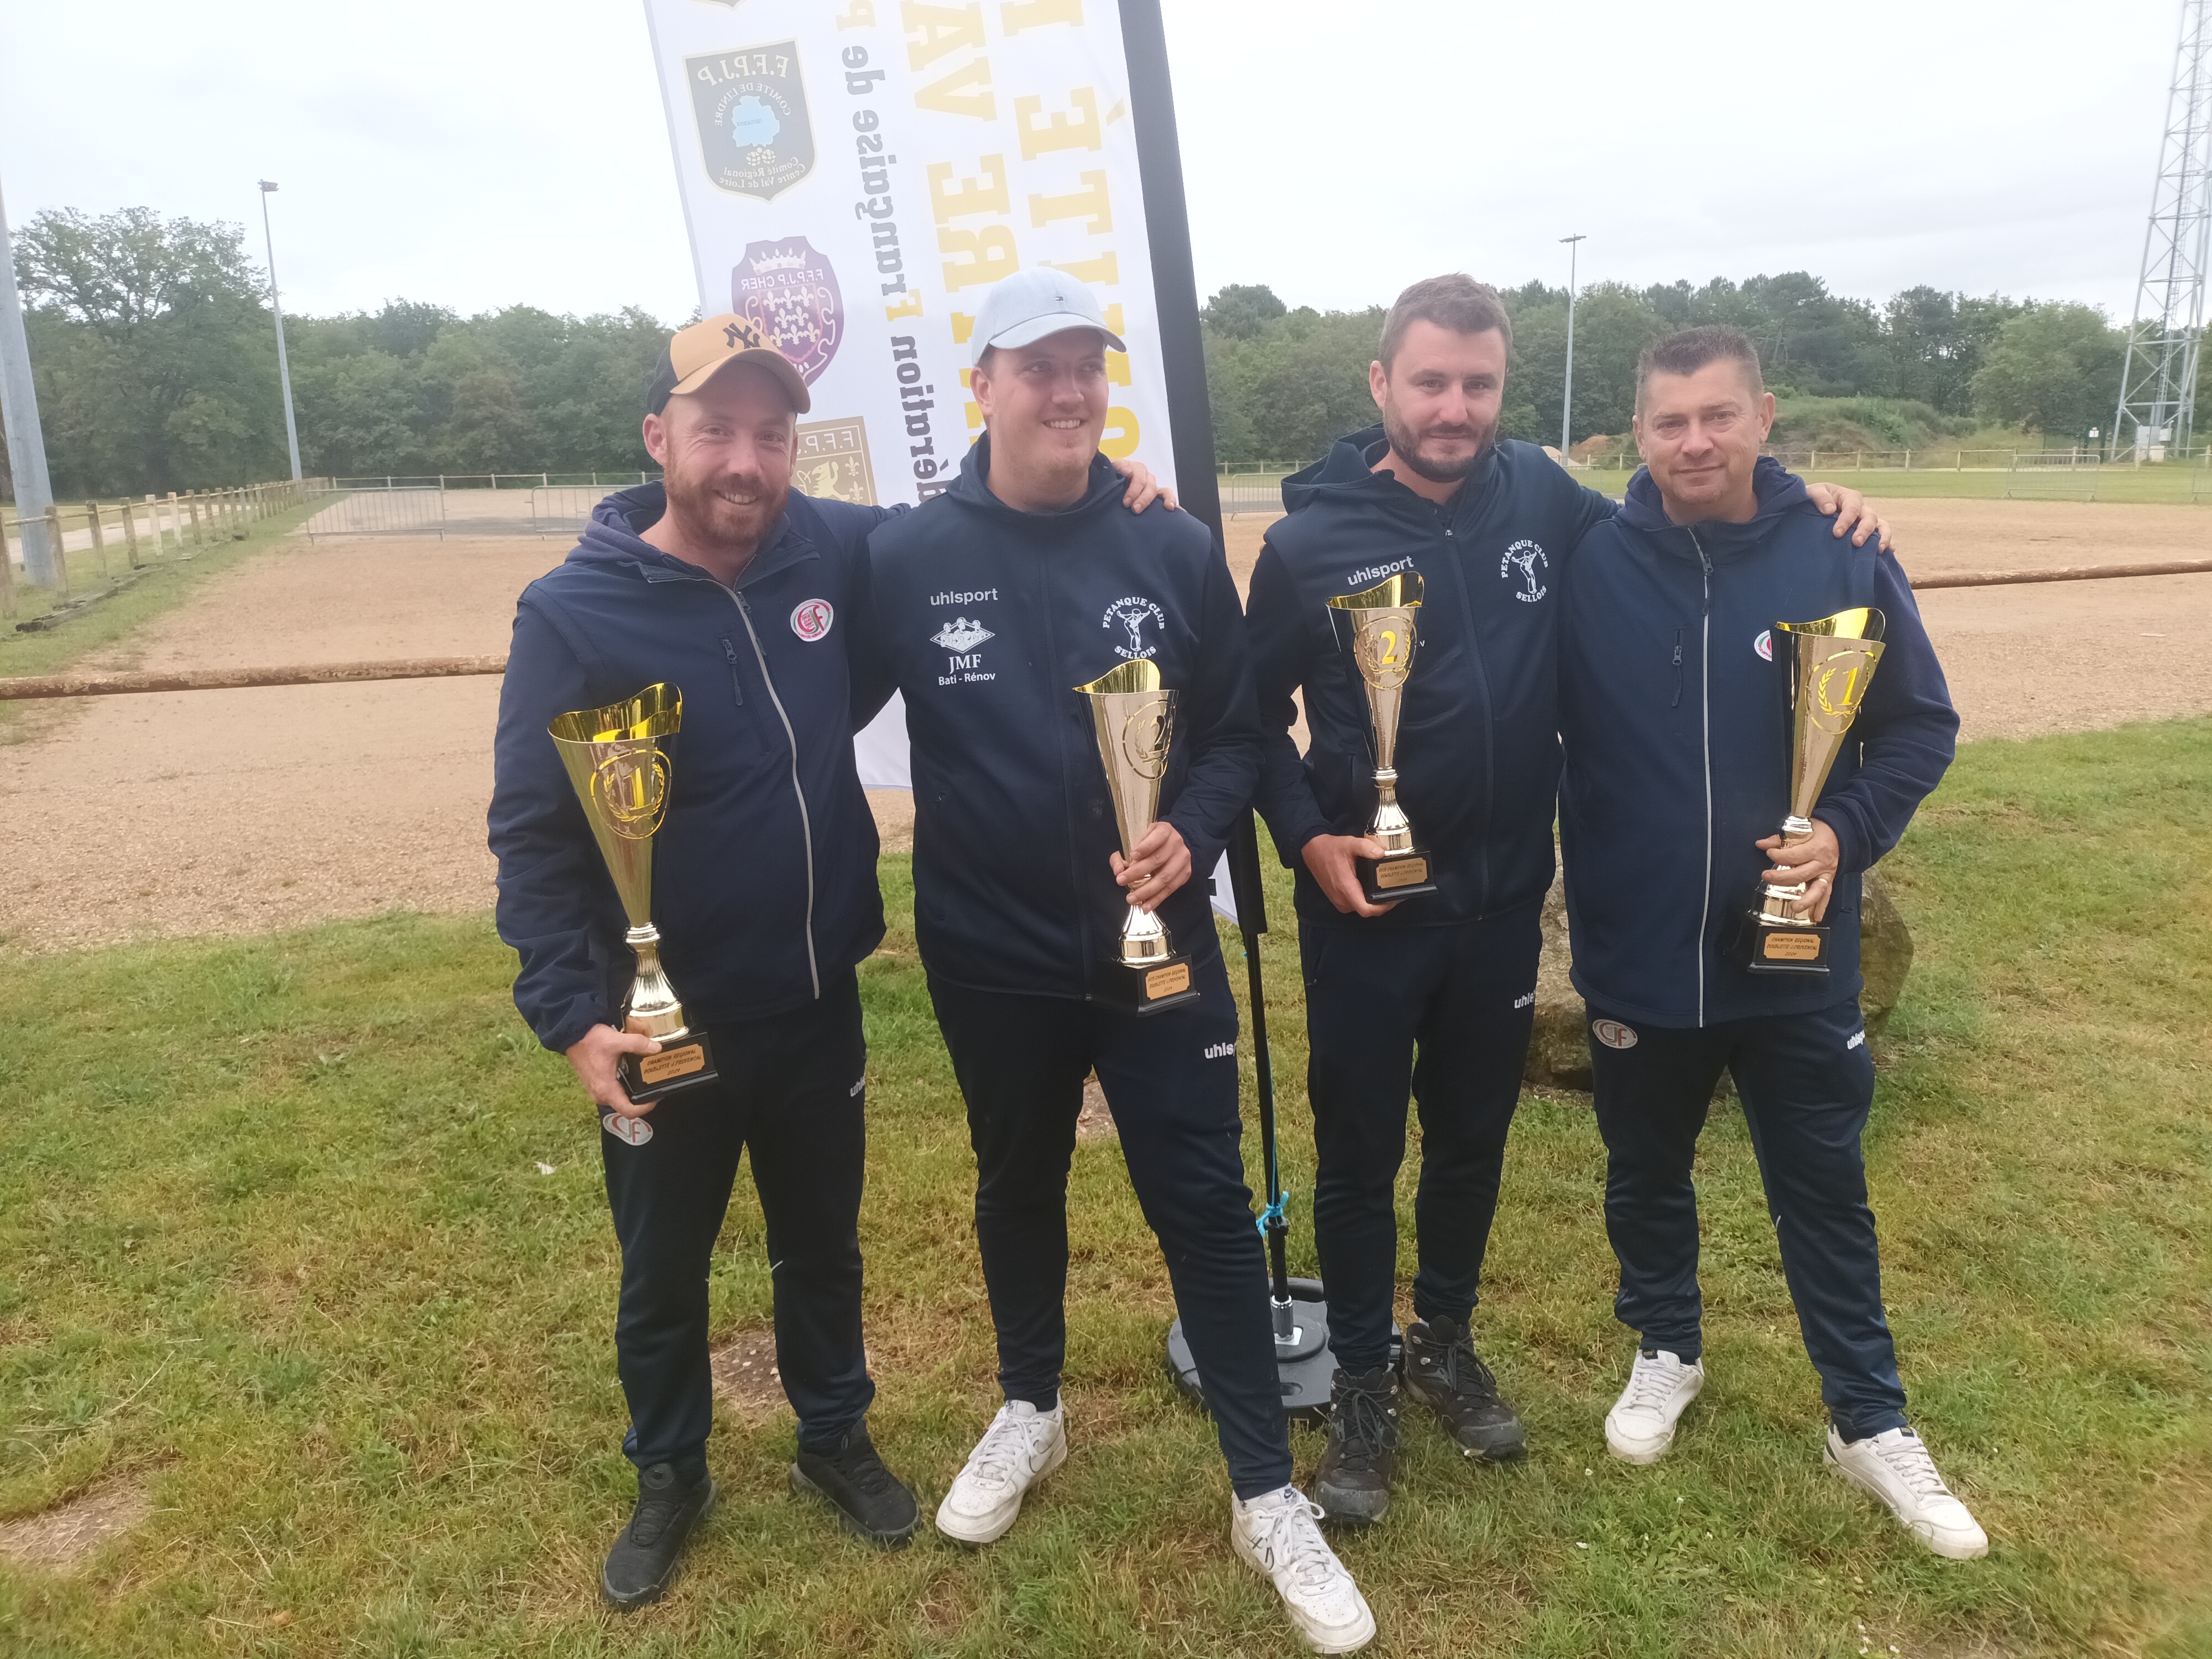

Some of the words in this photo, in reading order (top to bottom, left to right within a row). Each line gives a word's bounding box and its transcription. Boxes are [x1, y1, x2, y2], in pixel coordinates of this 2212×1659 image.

[1348, 556, 1414, 586] uhlsport
[1501, 540, 1533, 578] PETANQUE
[930, 588, 998, 606] uhlsport
[1516, 586, 1547, 602] SELLOIS
[1103, 597, 1147, 629] PETANQUE
[1149, 603, 1165, 629] CLUB
[1115, 645, 1156, 659] SELLOIS
[1379, 630, 1399, 665] 2
[948, 654, 982, 675] JMF
[938, 675, 957, 686] Bati
[964, 672, 996, 682] Rénov
[1837, 667, 1858, 706] 1
[1149, 715, 1166, 753] 2
[1204, 1042, 1236, 1059] uhls
